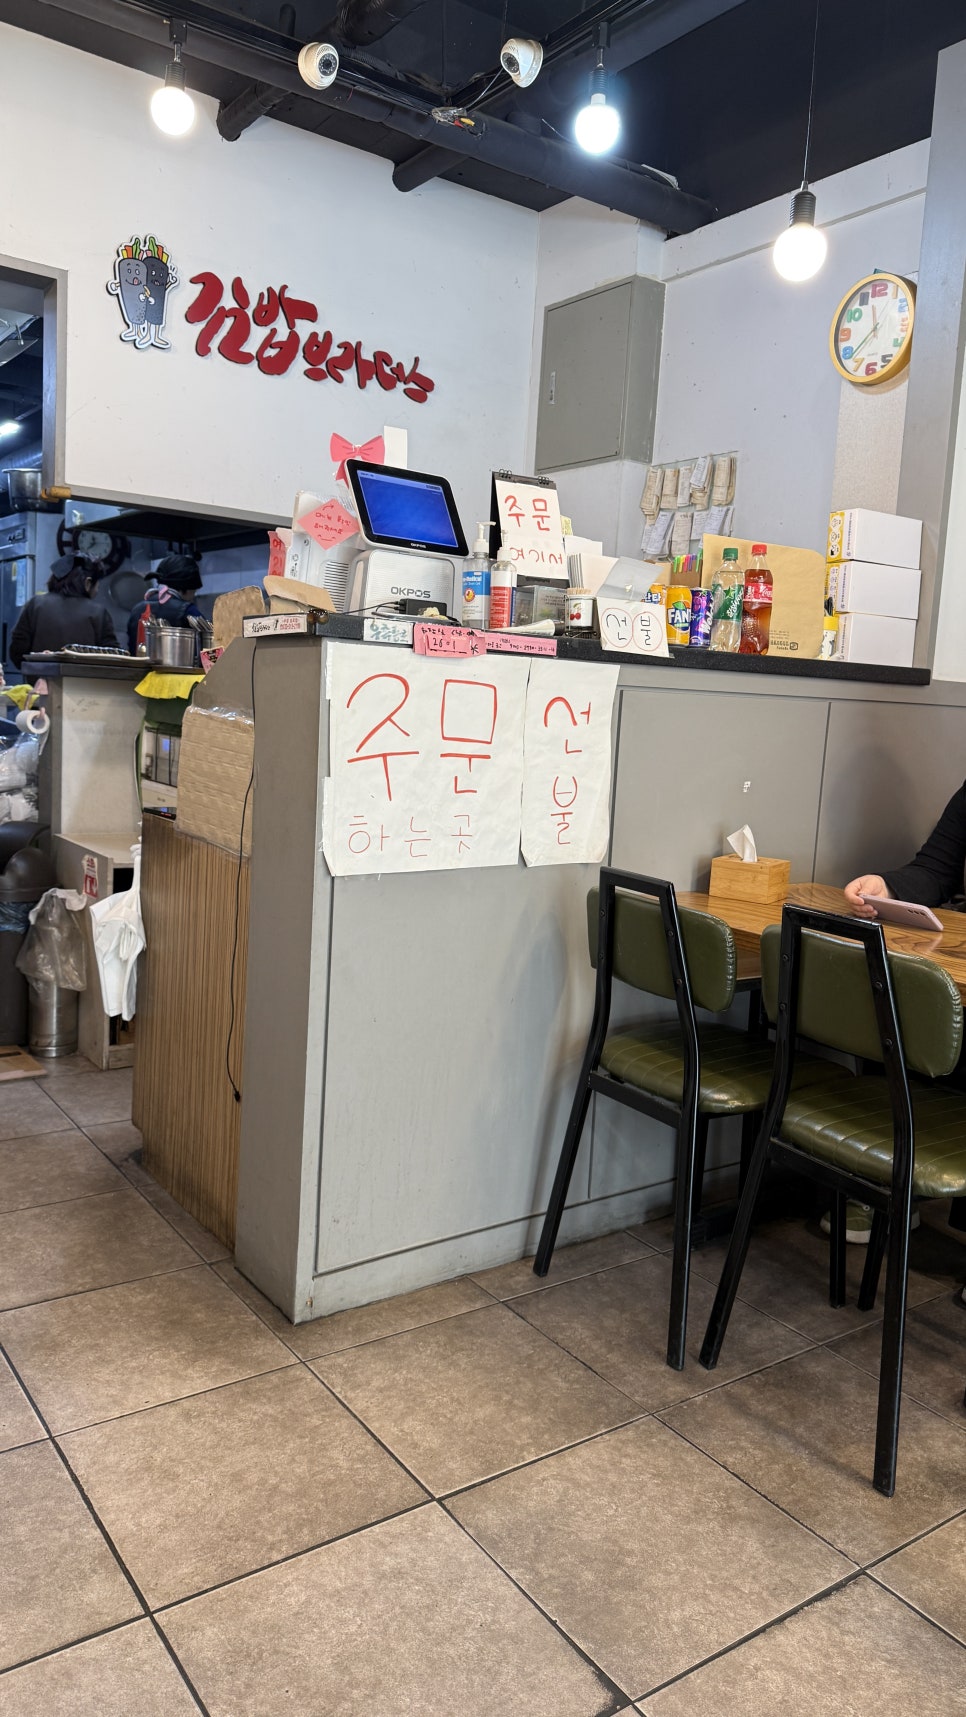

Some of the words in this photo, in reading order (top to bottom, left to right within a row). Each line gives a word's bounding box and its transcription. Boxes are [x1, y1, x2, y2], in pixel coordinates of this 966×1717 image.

[871, 282, 888, 298] 12
[846, 307, 863, 323] 10
[840, 327, 852, 342] 9
[842, 345, 854, 360] 8
[853, 357, 865, 372] 7
[864, 361, 878, 376] 6
[504, 494, 551, 532] 주문
[509, 546, 563, 565] 여기서
[390, 586, 431, 599] OKPOS
[667, 608, 692, 624] FAN
[346, 672, 498, 802] 주문
[544, 696, 592, 845] 선불
[348, 815, 432, 858] 하는
[451, 814, 473, 854] 곳
